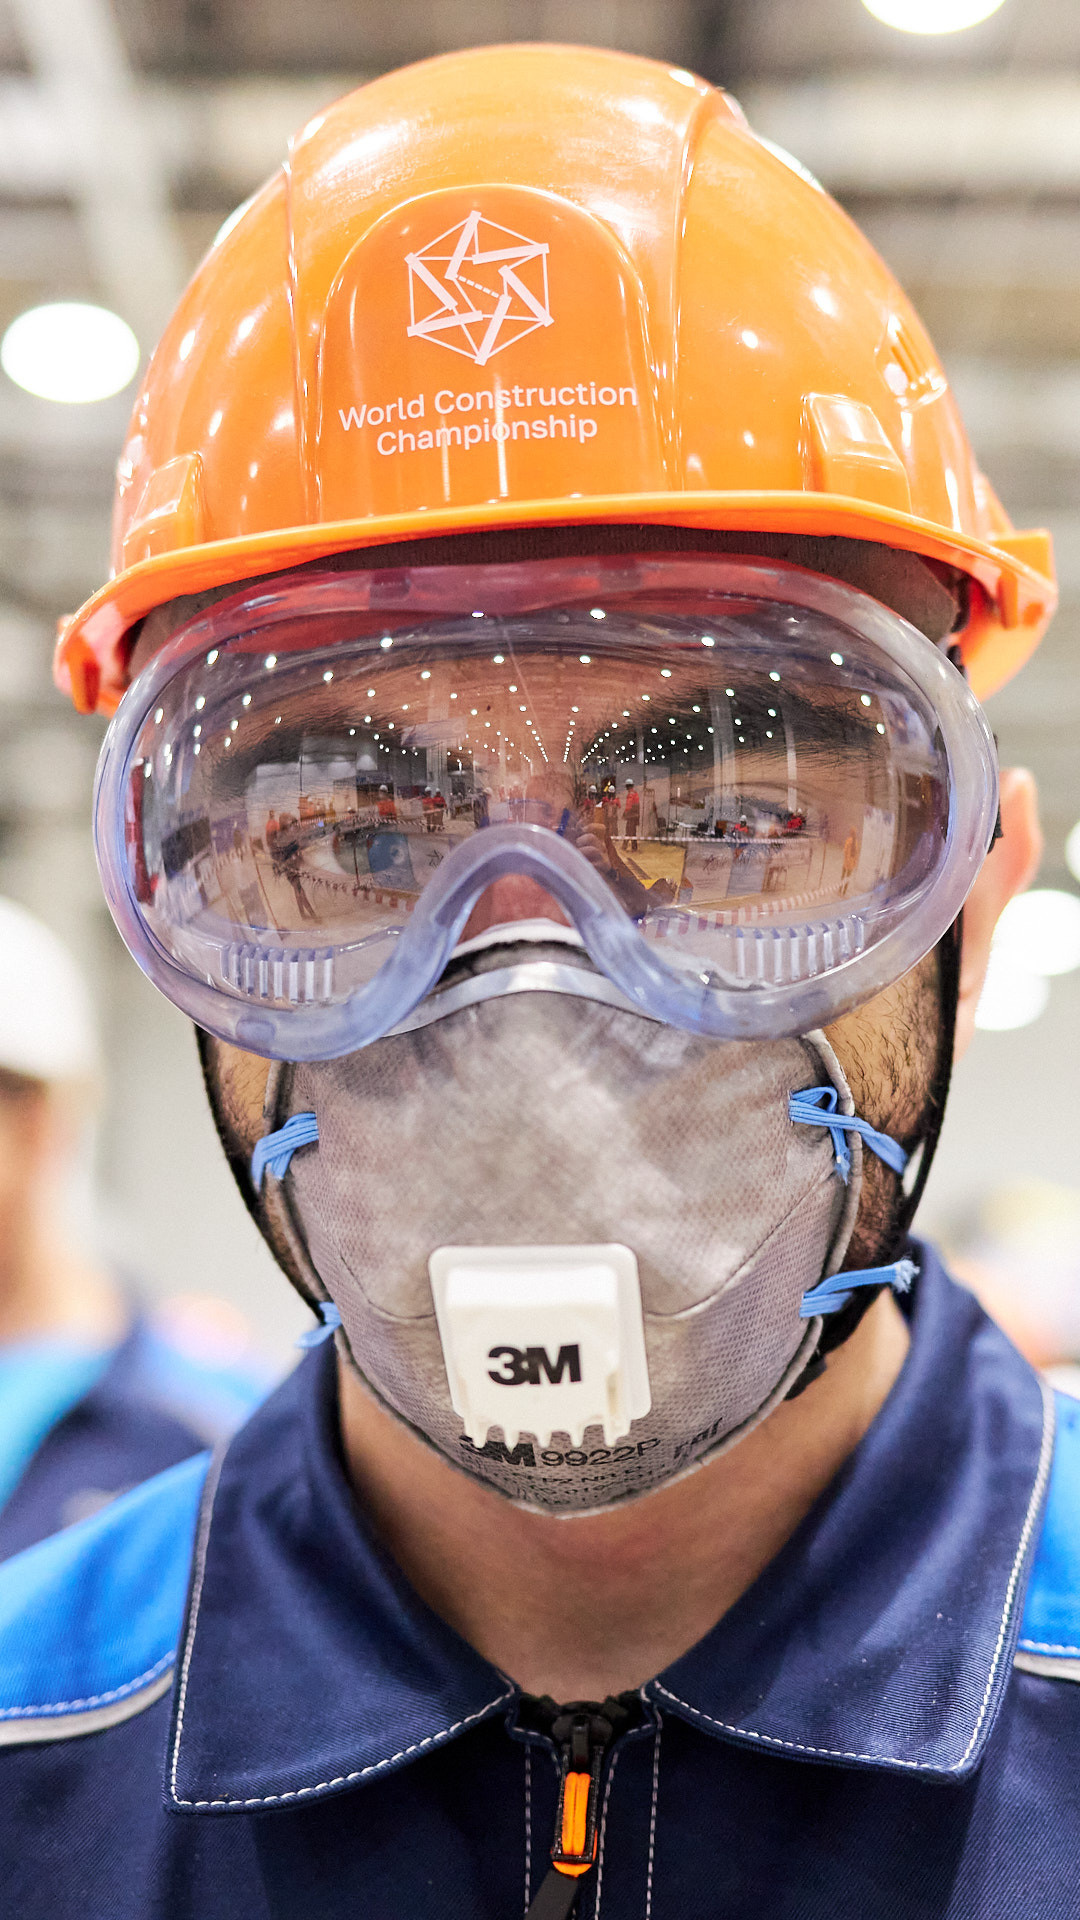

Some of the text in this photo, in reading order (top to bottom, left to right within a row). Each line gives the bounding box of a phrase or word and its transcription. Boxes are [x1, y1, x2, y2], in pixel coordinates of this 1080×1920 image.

[338, 382, 637, 431] World Construction
[376, 414, 598, 456] Championship
[487, 1344, 582, 1386] 3M
[540, 1437, 661, 1467] 9922P
